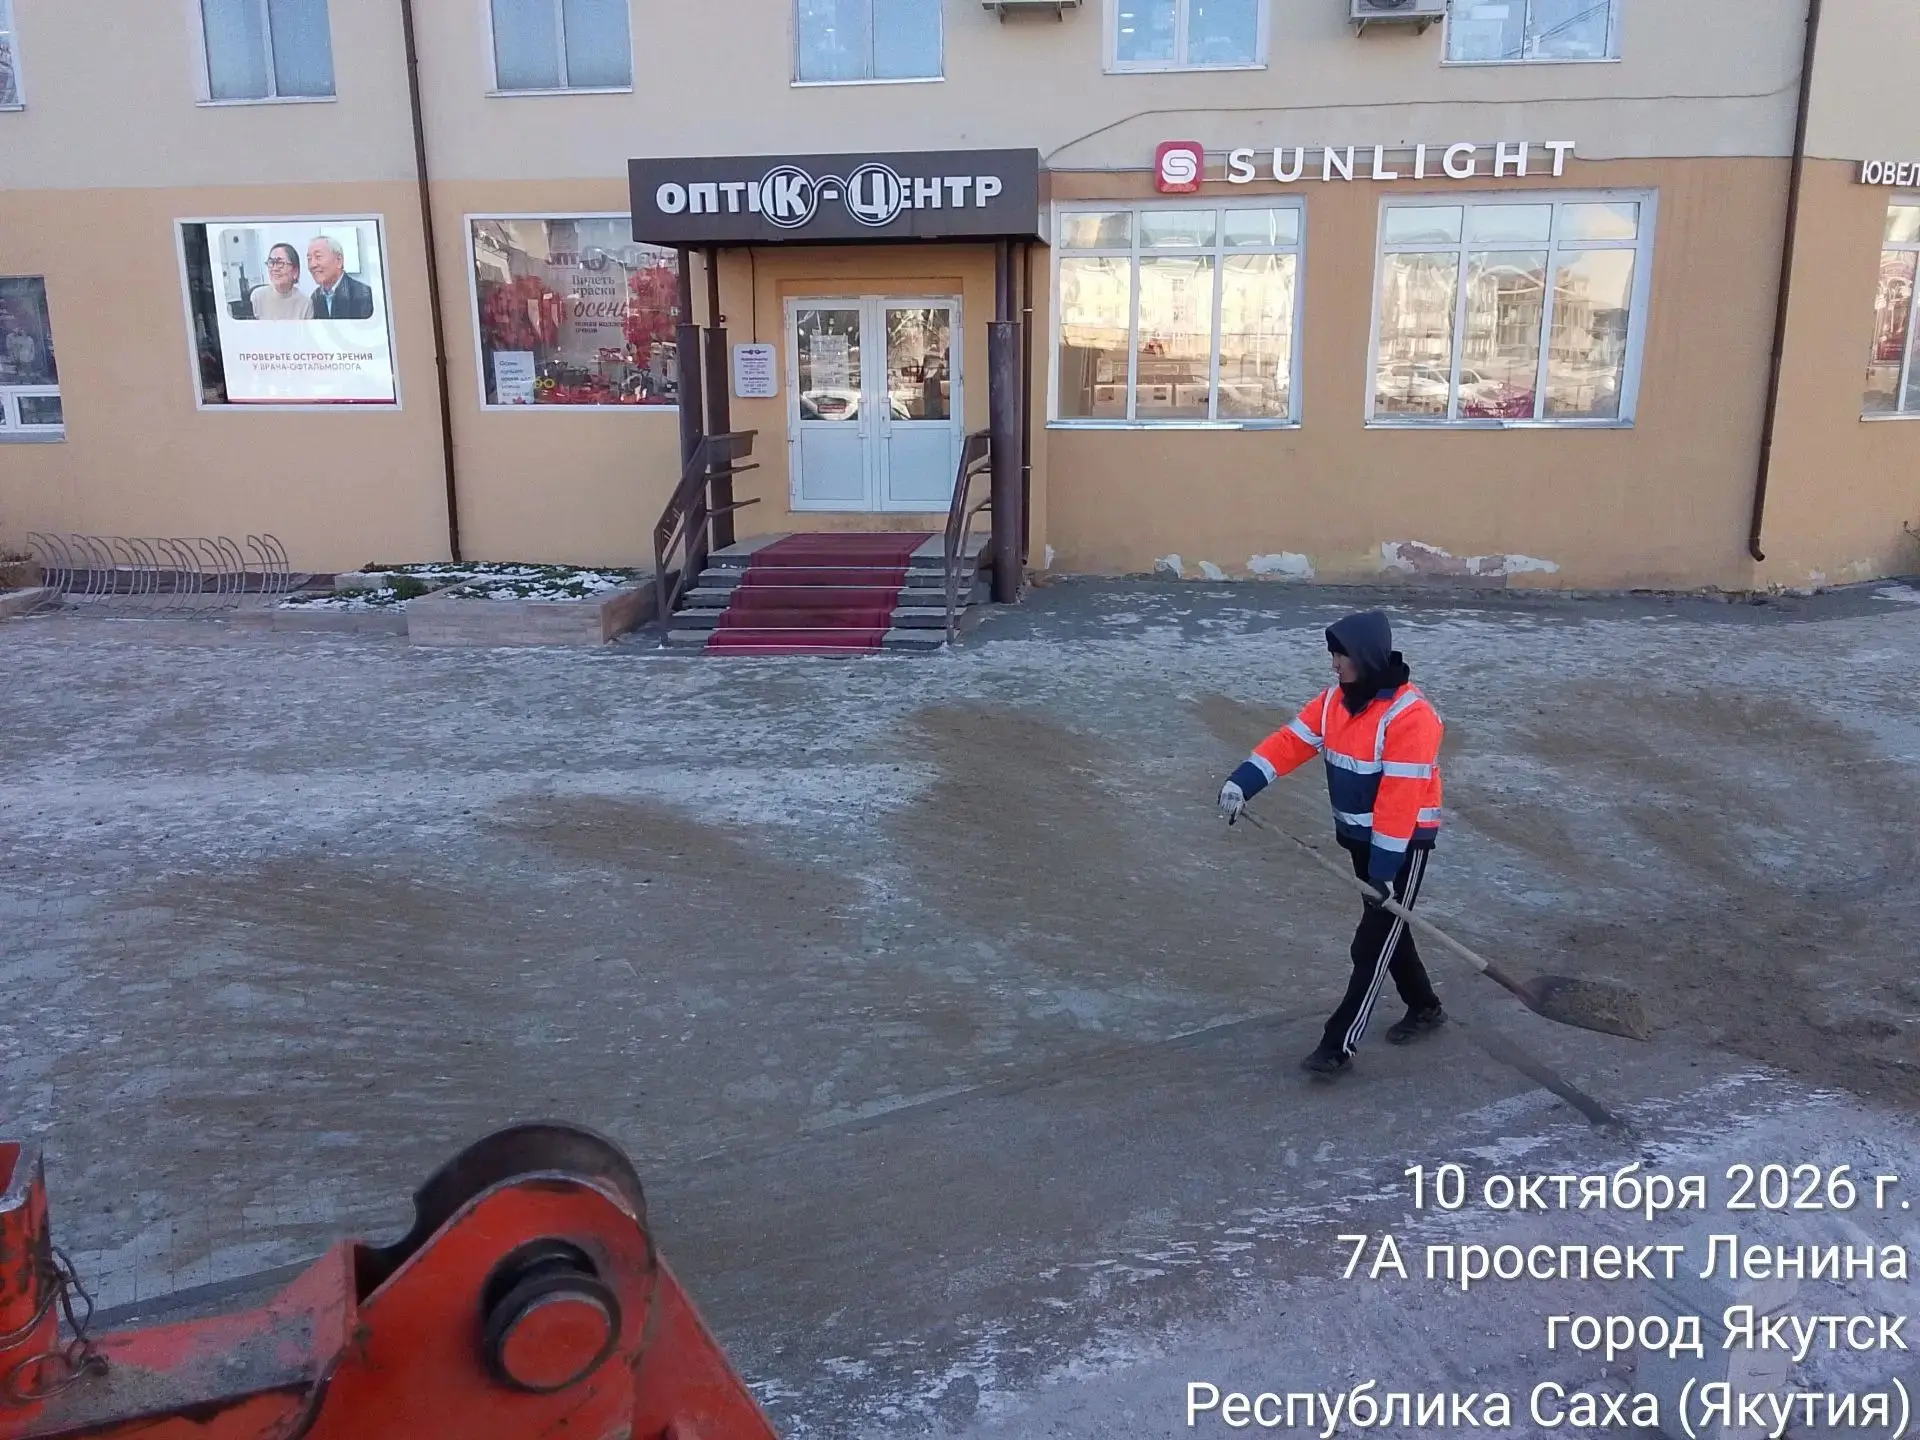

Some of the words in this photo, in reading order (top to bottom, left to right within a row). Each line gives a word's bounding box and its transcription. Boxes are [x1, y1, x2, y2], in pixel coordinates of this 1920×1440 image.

[1227, 140, 1575, 184] SUNLIGHT
[656, 170, 1003, 222] ОПТИК-ЦЕНТР
[572, 287, 616, 298] краски
[239, 352, 290, 361] ПРОВЕРЬТЕ
[291, 352, 335, 361] ОСТРОТУ
[337, 352, 373, 361] ЗРЕНИЯ
[253, 363, 259, 371] У
[260, 363, 361, 371] ВРАЧА-ОФТАЛЬМОЛОГА
